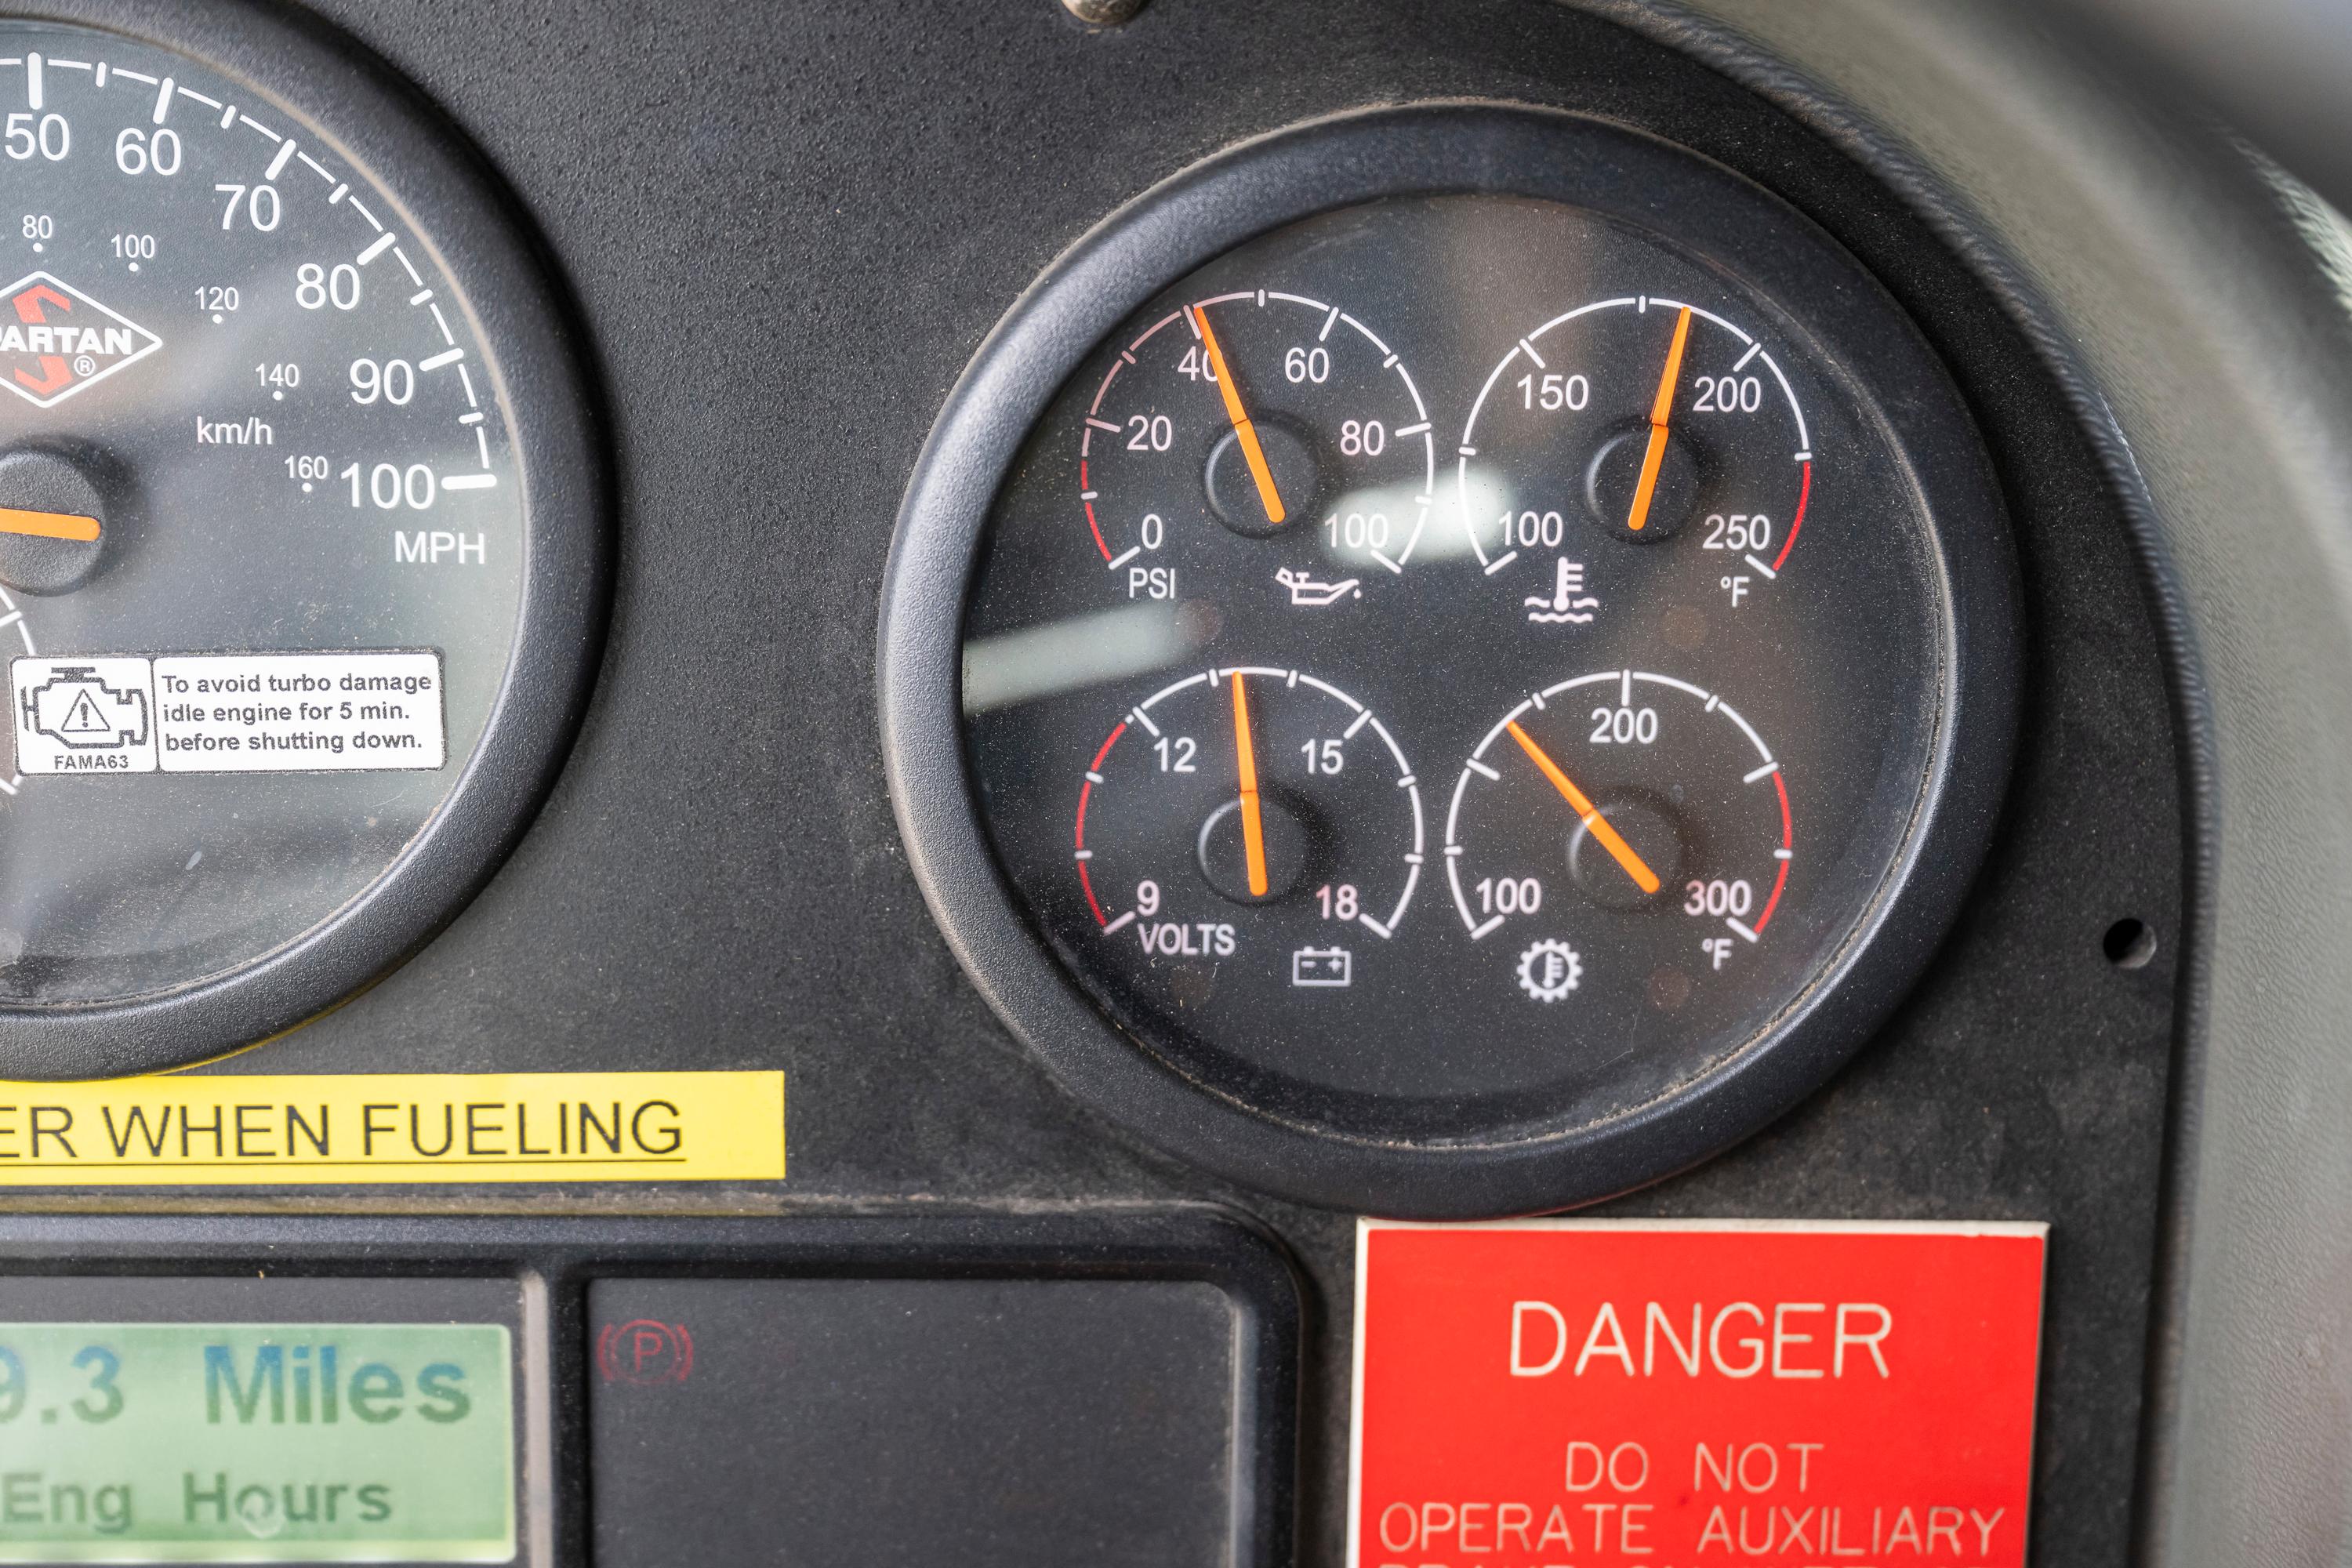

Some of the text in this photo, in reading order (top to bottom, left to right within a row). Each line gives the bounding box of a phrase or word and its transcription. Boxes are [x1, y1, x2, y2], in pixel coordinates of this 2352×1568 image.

[4, 114, 71, 161] 50
[115, 129, 182, 176] 60
[215, 184, 281, 231] 70
[21, 214, 54, 239] 80
[111, 235, 156, 259] 100
[194, 286, 239, 310] 120
[296, 263, 361, 310] 80
[0, 326, 132, 354] ARTAN
[255, 363, 300, 387] 140
[349, 359, 414, 405] 90
[1284, 347, 1330, 383] 60
[1516, 374, 1589, 411] 150
[1693, 377, 1762, 412] 200
[196, 417, 274, 445] km/h
[1127, 415, 1173, 452] 20
[1339, 419, 1385, 456] 80
[285, 456, 328, 480] 160
[340, 463, 435, 510] 100
[1141, 514, 1163, 550] 0
[1323, 513, 1389, 549] 100
[1498, 510, 1563, 547] 100
[1702, 514, 1771, 550] 250
[394, 532, 485, 564] MPH
[1128, 568, 1176, 599] PSI
[162, 673, 432, 695] To avoid turbo damage
[163, 701, 411, 726] idle engine for 5 min.
[1589, 707, 1658, 744] 200
[165, 730, 423, 753] before shutting down.
[1154, 737, 1196, 772] 12
[1301, 739, 1344, 775] 15
[54, 754, 129, 770] FAMA63
[1137, 880, 1160, 916] 9
[1316, 884, 1359, 920] 18
[1475, 877, 1542, 915] 100
[1683, 879, 1752, 916] 300
[1137, 923, 1236, 956] VOLTS
[101, 1105, 331, 1157] WHEN
[363, 1100, 684, 1156] FUELING
[1510, 1301, 1893, 1380] DANGER
[203, 1345, 473, 1425] Miles
[1565, 1441, 1825, 1494] DO NOT
[2, 1472, 394, 1534] Eng Hours
[1379, 1502, 2006, 1557] OPERATE AUXILIARY
